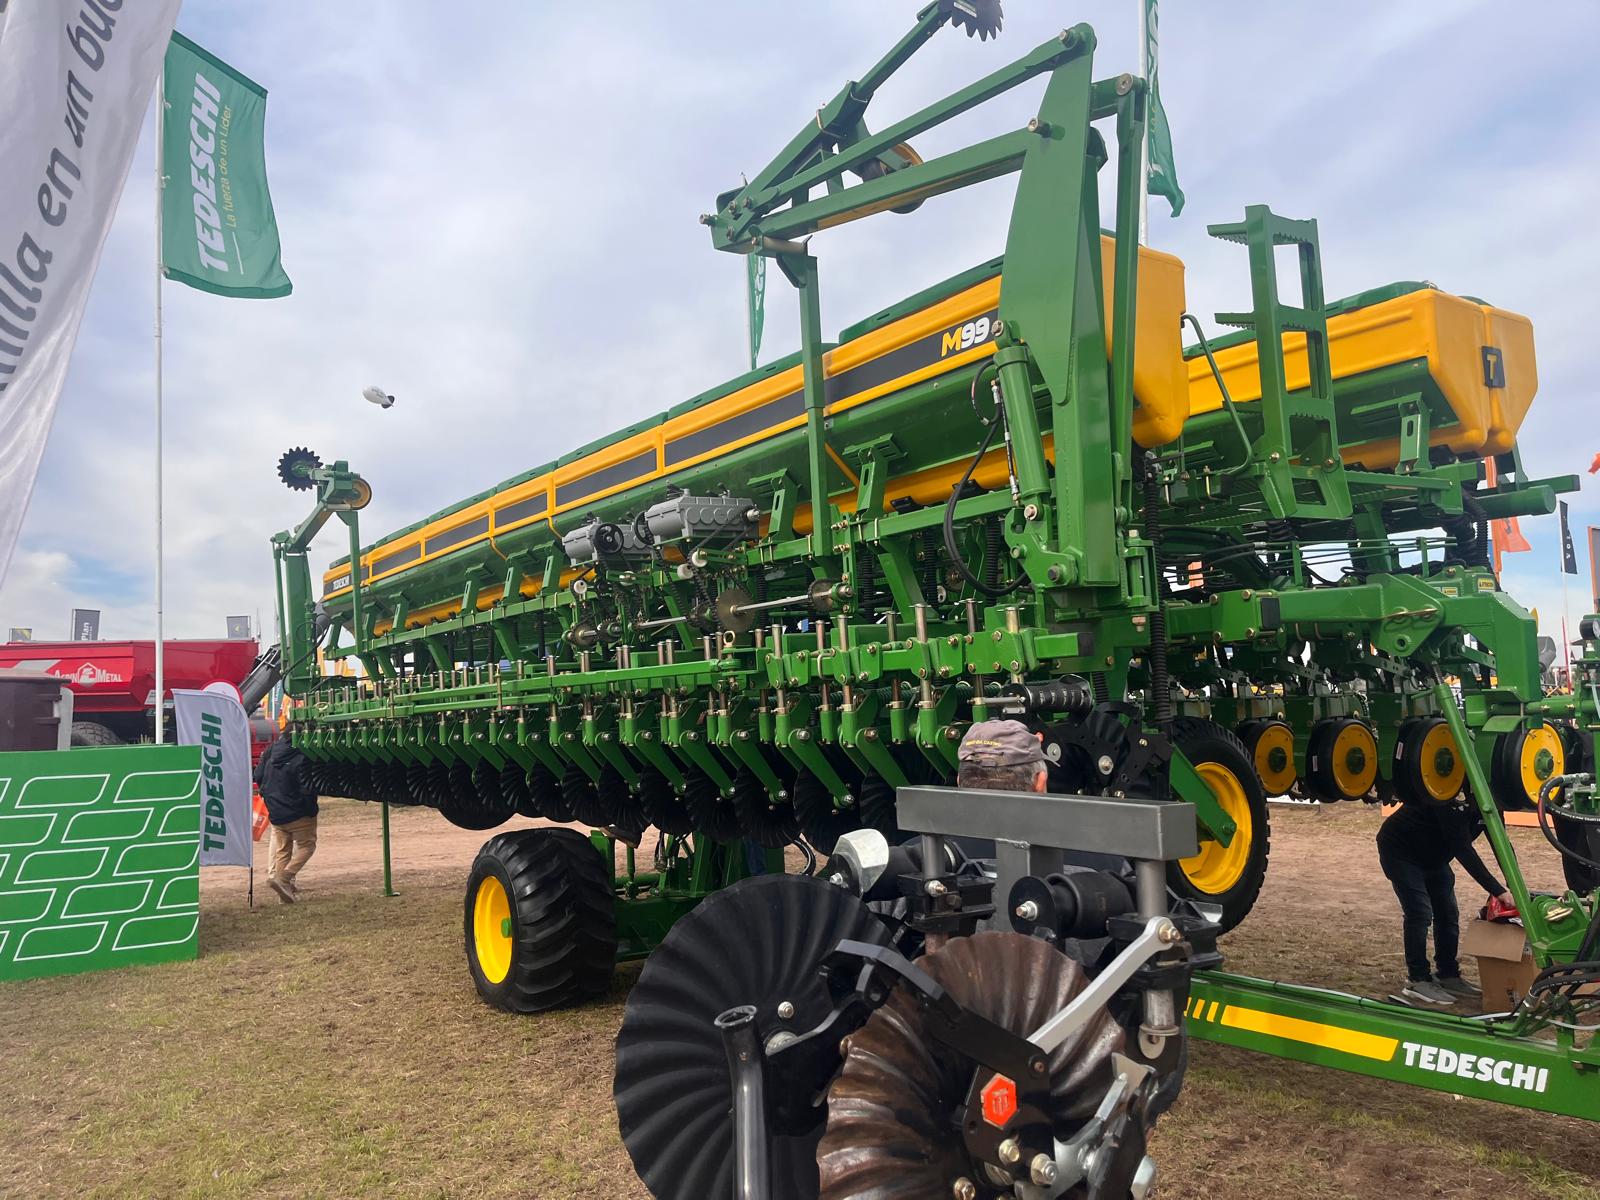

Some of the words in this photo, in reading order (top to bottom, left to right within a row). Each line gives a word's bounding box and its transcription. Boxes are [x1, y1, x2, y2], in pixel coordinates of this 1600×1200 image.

[37, 147, 81, 228] en
[64, 70, 94, 148] un
[218, 140, 228, 155] un
[218, 158, 228, 175] de
[189, 72, 229, 272] TEDESCHI
[219, 177, 233, 211] fuerza
[225, 214, 237, 229] La
[941, 316, 990, 357] M99
[201, 712, 227, 852] TEDESCHI
[1402, 1041, 1549, 1093] TEDESCHI
